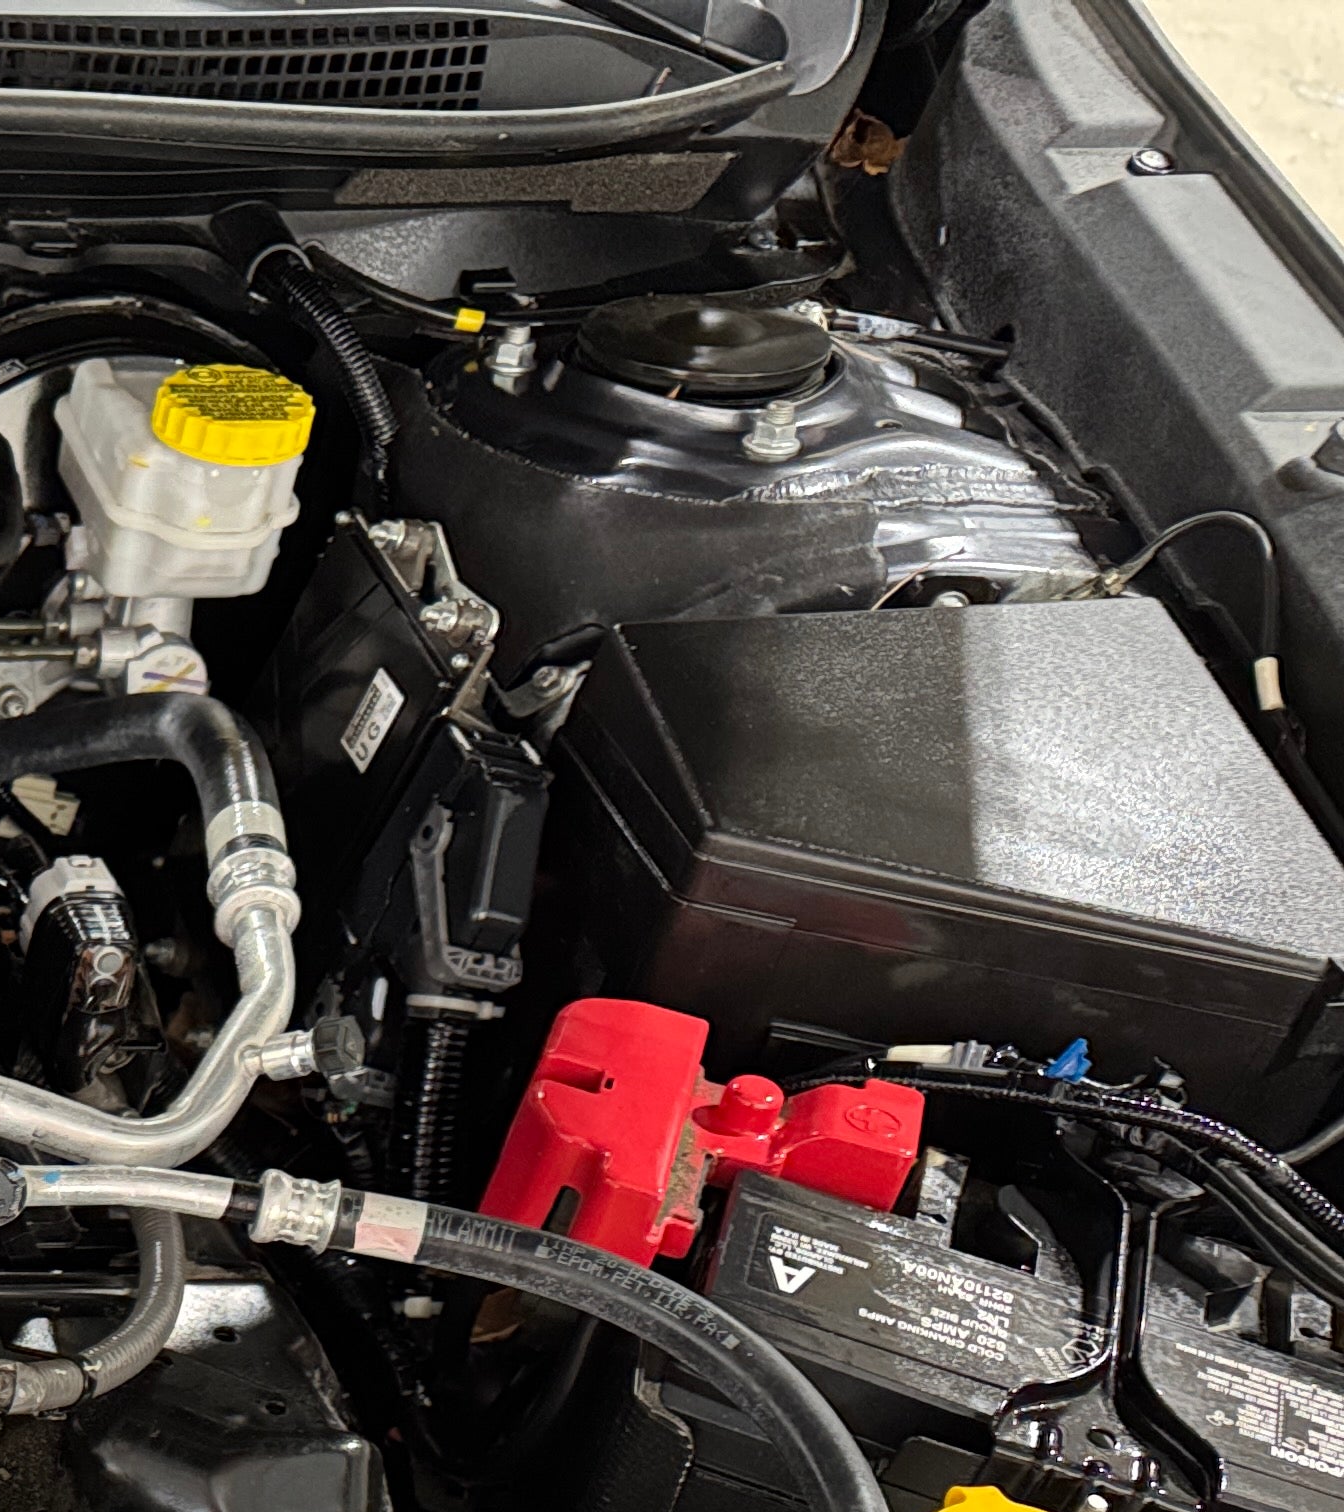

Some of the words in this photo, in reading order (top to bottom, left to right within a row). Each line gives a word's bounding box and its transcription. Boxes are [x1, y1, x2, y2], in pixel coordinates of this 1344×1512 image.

[426, 1211, 519, 1254] HYLAMMIT
[857, 1306, 895, 1326] AMPS
[929, 1306, 959, 1322] SIZE
[895, 1319, 965, 1349] CRANKING
[919, 1315, 970, 1339] AMPS
[966, 1342, 1005, 1362] COLD
